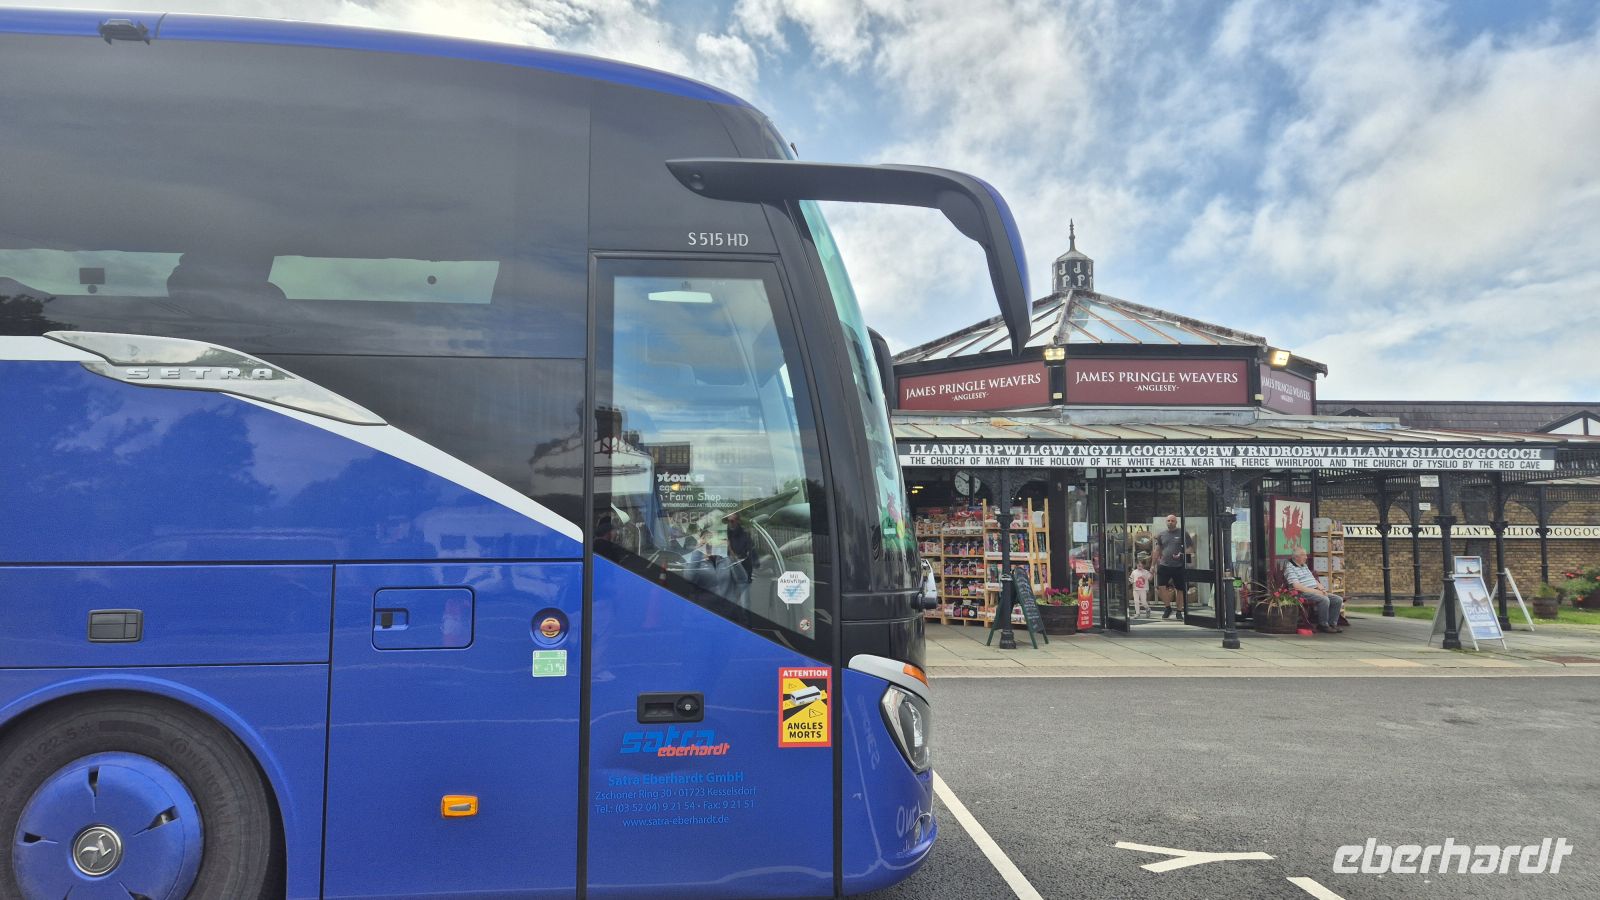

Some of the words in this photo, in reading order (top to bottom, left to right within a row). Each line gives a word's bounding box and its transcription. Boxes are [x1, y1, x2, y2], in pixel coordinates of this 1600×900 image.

[688, 231, 697, 246] S
[699, 232, 724, 247] 515
[726, 232, 749, 247] HD
[126, 367, 274, 380] SETRA
[1075, 371, 1115, 384] JAMES
[1118, 371, 1175, 383] PRINGLE
[1178, 371, 1238, 383] WEAVERS
[905, 385, 936, 400] JAMES
[938, 379, 985, 395] PRINGLE
[988, 372, 1041, 389] WEAVERS
[1133, 384, 1180, 392] -ANGLESEY-
[951, 391, 989, 402] -ANGLESEY-
[911, 457, 926, 465] THE
[930, 457, 964, 465] CHURCH
[970, 457, 980, 465] OF
[986, 457, 1010, 466] MARY
[1015, 457, 1023, 466] IN
[1029, 457, 1044, 466] THE
[1050, 457, 1085, 466] HOLLOW
[1090, 457, 1100, 466] OF
[1107, 457, 1122, 466] THE
[1128, 458, 1154, 466] WHITE
[1160, 458, 1186, 467] HAZEL
[1191, 458, 1214, 467] NEAR
[1220, 458, 1236, 467] THE
[1242, 458, 1269, 467] FIERCE
[1276, 458, 1324, 467] WHIRLPOOL
[1330, 459, 1347, 468] AND
[1353, 459, 1368, 468] THE
[1373, 459, 1407, 468] CHURCH
[1412, 459, 1423, 468] OF
[1427, 459, 1458, 468] TYSILIO
[1463, 459, 1473, 469] BY
[1479, 459, 1494, 469] THE
[1499, 459, 1514, 469] RED
[1520, 459, 1540, 469] CAVE
[669, 492, 694, 501] Farm
[697, 492, 722, 503] Shop
[782, 669, 829, 678] ATTENTION
[786, 722, 824, 731] ANGLES
[620, 725, 715, 753] satra
[788, 730, 823, 739] MORTS
[657, 743, 731, 757] eberhardt
[608, 774, 641, 786] Satra
[643, 773, 704, 785] Eberhardt
[706, 771, 744, 783] GmbH
[595, 790, 637, 801] Zschoner
[639, 789, 659, 800] Ring
[662, 789, 672, 798] 30
[678, 787, 705, 798] 01723
[707, 786, 757, 797] Kesselsdorf
[615, 804, 630, 814] (03
[632, 804, 644, 812] 52
[646, 803, 660, 813] 04)
[670, 802, 682, 811] 21
[684, 802, 696, 811] 54
[703, 800, 720, 810] Fax:
[730, 800, 742, 809] 21
[744, 800, 755, 808] 51
[622, 814, 729, 827] www.satra-eberhardt.de
